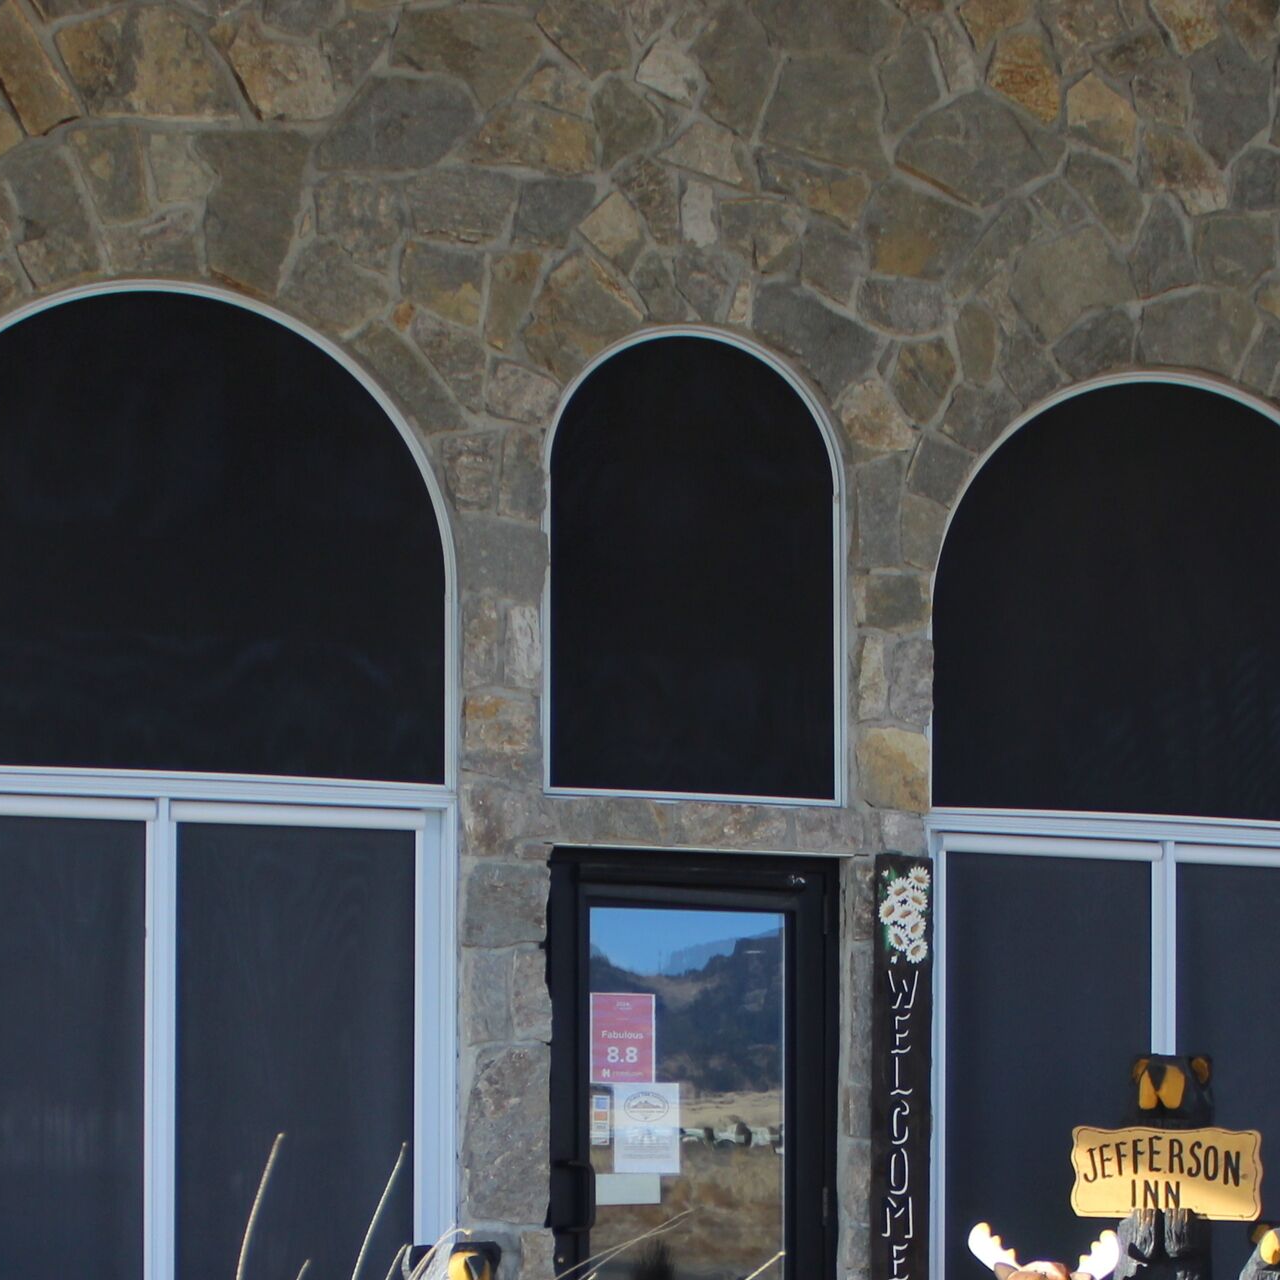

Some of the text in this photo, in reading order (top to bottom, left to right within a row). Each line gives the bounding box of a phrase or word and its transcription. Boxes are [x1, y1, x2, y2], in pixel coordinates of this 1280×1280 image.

[601, 1030, 644, 1040] Fabulous
[607, 1046, 638, 1063] 8.8
[1083, 1136, 1241, 1187] JEFFERSON
[1131, 1179, 1180, 1208] INN
